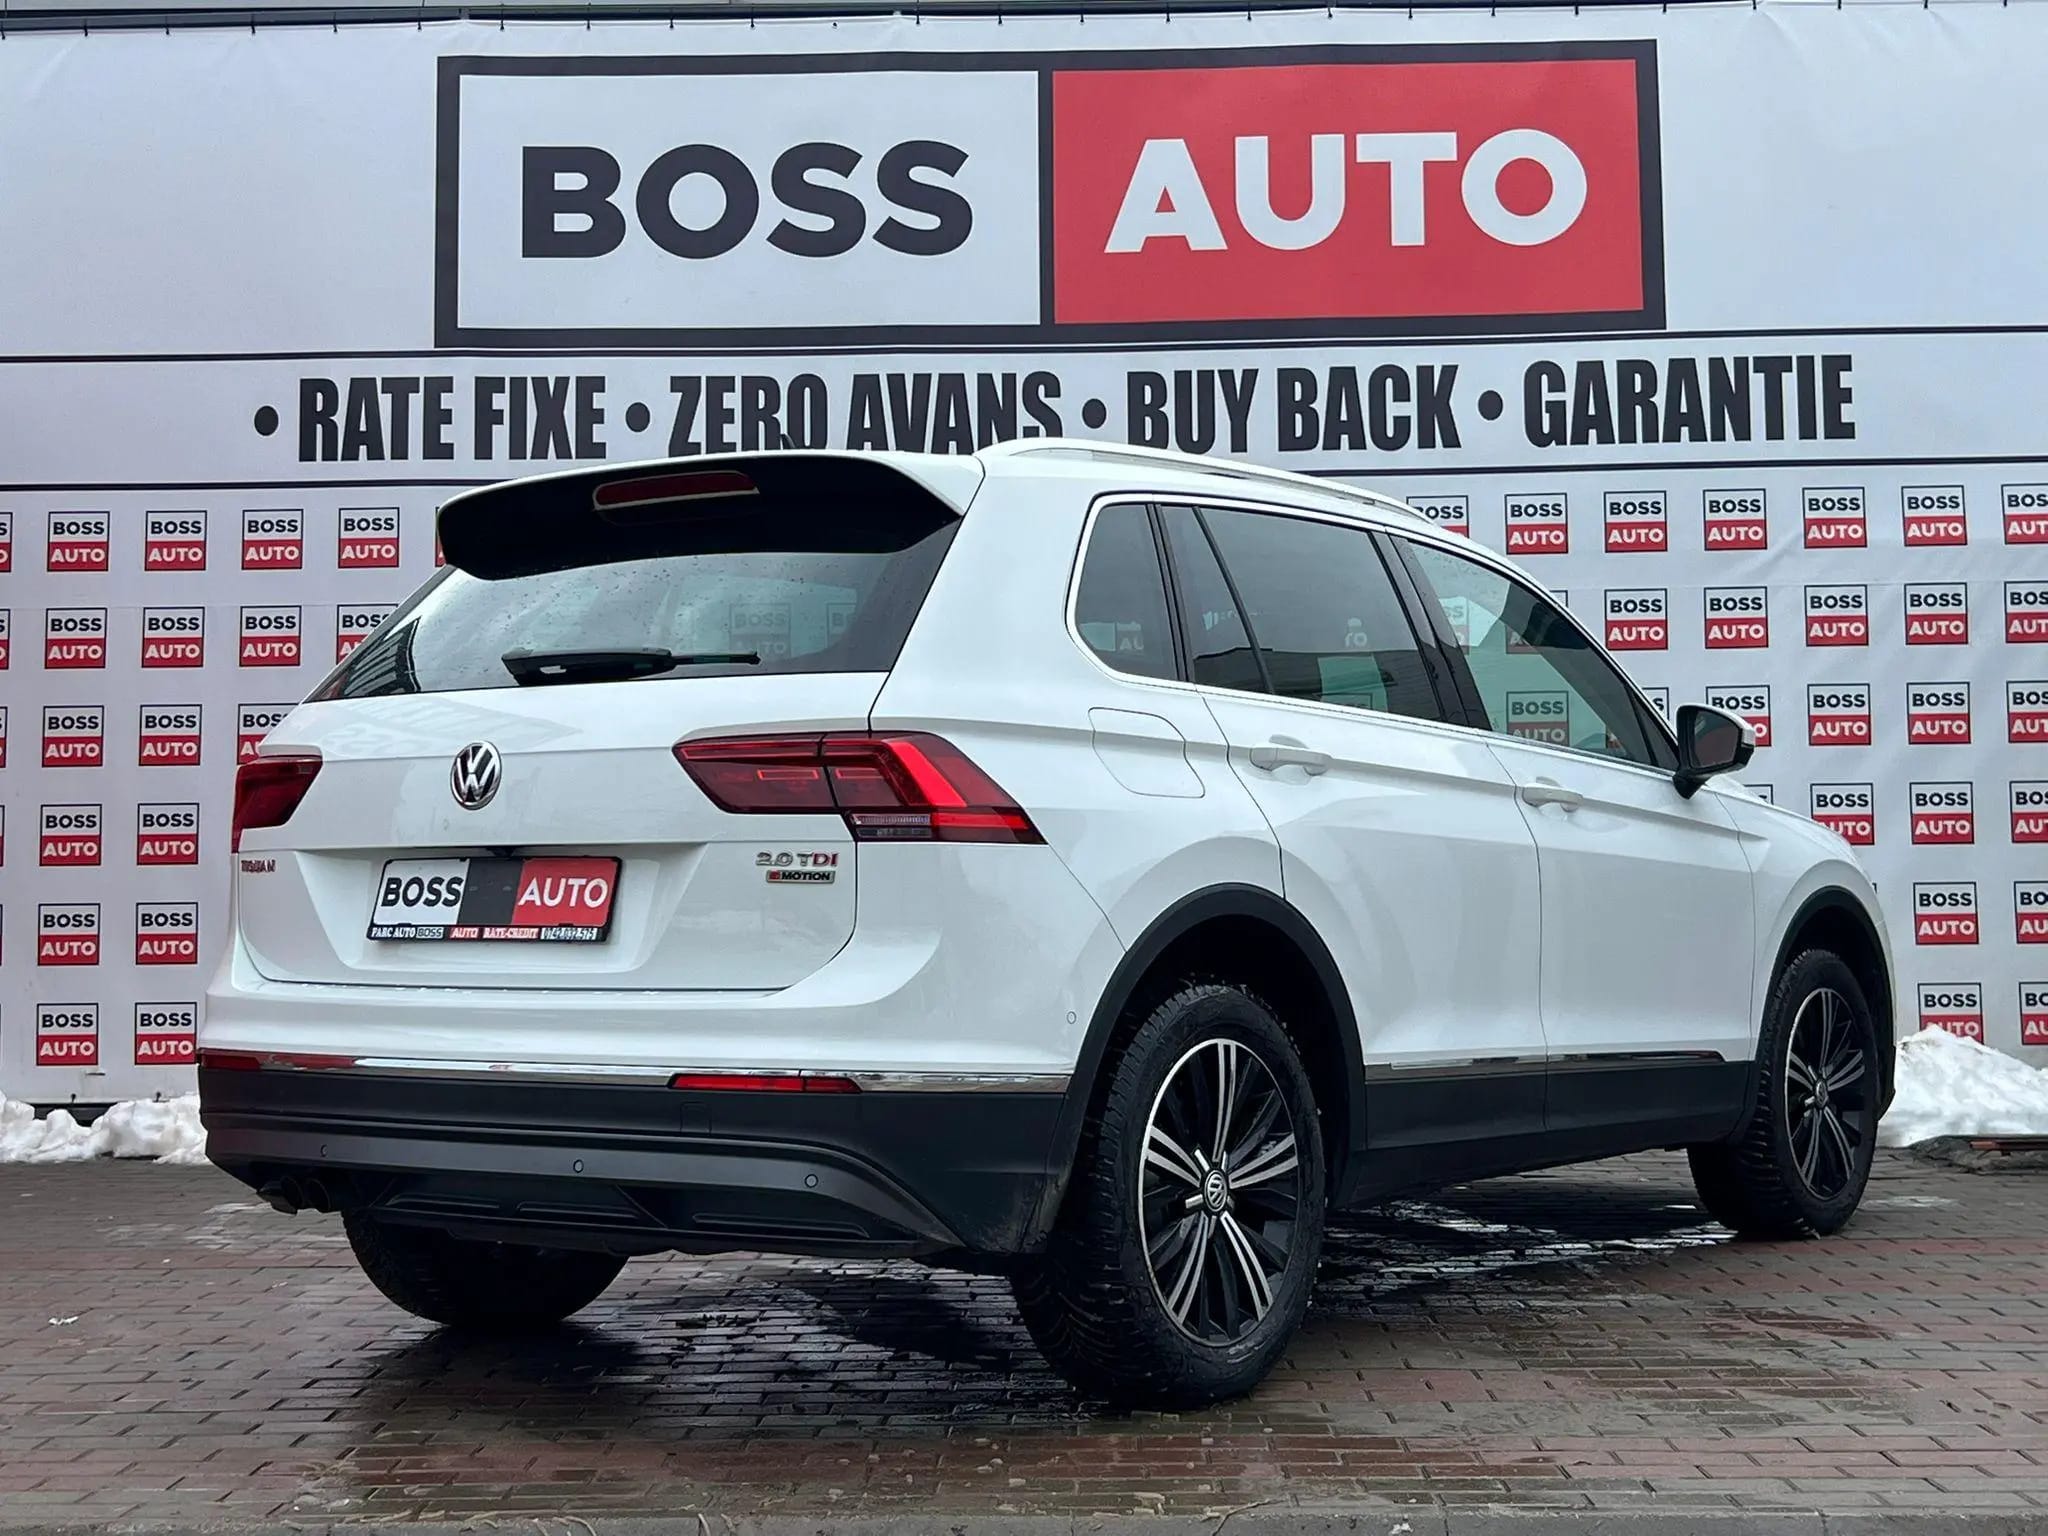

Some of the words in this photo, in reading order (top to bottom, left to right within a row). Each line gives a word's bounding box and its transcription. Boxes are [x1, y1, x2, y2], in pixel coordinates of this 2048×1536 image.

[522, 139, 972, 259] BOSS
[1104, 127, 1586, 252] AUTO
[300, 376, 454, 462] RATE
[474, 375, 606, 461] FIXE
[668, 373, 828, 457] ZERO
[847, 371, 1063, 455] AVANS
[1127, 368, 1258, 454] BUY
[1277, 363, 1462, 452] BACK
[1524, 354, 1856, 448] GARANTIE
[1709, 499, 1761, 513] BOSS
[1808, 497, 1860, 511] BOSS
[1907, 495, 1960, 510] BOSS
[2008, 494, 2048, 507] BOS
[1511, 503, 1562, 517] BOSS
[1610, 501, 1662, 515] BOSS
[53, 522, 104, 535] BOSS
[151, 521, 201, 534] BOSS
[248, 519, 298, 533] BOSS
[344, 518, 394, 531] BOSS
[1907, 523, 1963, 537] AUTO
[2008, 521, 2048, 535] AUT
[1509, 531, 1564, 545] AUTO
[1608, 528, 1664, 543] AUTO
[1708, 526, 1763, 541] AUTO
[1808, 525, 1863, 539] AUTO
[51, 549, 105, 562] AUTO
[148, 548, 202, 561] AUTO
[246, 546, 299, 560] AUTO
[342, 545, 395, 559] AUTO
[1710, 597, 1762, 611] BOSS
[1810, 595, 1862, 609] BOSS
[1910, 593, 1962, 607] BOSS
[2010, 592, 2048, 605] BOS
[1610, 599, 1662, 613] BOSS
[51, 618, 102, 631] BOSS
[148, 617, 199, 630] BOSS
[246, 616, 296, 629] BOSS
[342, 614, 389, 628] BOS
[1909, 621, 1964, 635] AUTO
[2009, 619, 2048, 633] AUT
[1609, 627, 1664, 641] AUTO
[1709, 624, 1764, 639] AUTO
[1810, 622, 1865, 637] AUTO
[48, 645, 102, 659] AUTO
[145, 644, 200, 658] AUTO
[243, 643, 297, 657] AUTO
[1712, 696, 1765, 710] BOSS
[1814, 694, 1865, 708] BOSS
[1913, 693, 1965, 706] BOSS
[2013, 691, 2048, 705] BOS
[1512, 701, 1564, 715] BOSS
[48, 716, 98, 730] BOSS
[145, 715, 196, 728] BOSS
[243, 714, 288, 727] BOS
[1912, 720, 1967, 735] AUTO
[2012, 719, 2048, 733] AUT
[1812, 722, 1867, 736] AUTO
[45, 743, 99, 757] AUTO
[143, 742, 197, 756] AUTO
[1816, 794, 1869, 807] BOSS
[1915, 792, 1968, 806] BOSS
[46, 815, 97, 828] BOSS
[143, 813, 194, 827] BOSS
[1819, 822, 1870, 835] UTO
[1915, 820, 1970, 835] AUTO
[44, 842, 97, 856] AUTO
[140, 841, 194, 855] AUTO
[756, 852, 793, 867] 2.0
[797, 852, 838, 867] TDI
[381, 877, 464, 908] BOSS
[517, 877, 608, 909] AUTO
[1919, 893, 1972, 907] BOSS
[2020, 892, 2048, 905] BO
[44, 914, 95, 928] BOSS
[141, 913, 192, 927] BOSS
[2020, 920, 2048, 934] AU
[392, 927, 416, 938] AUTO
[417, 928, 443, 938] BOSS
[449, 928, 479, 938] AUTO
[1919, 921, 1974, 935] AUTO
[41, 942, 96, 956] AUTO
[139, 941, 194, 955] AUTO
[1924, 994, 1977, 1007] BOSS
[42, 1014, 93, 1028] BOSS
[140, 1013, 192, 1026] BOSS
[40, 1042, 94, 1056] AUTO
[138, 1041, 193, 1055] AUTO
